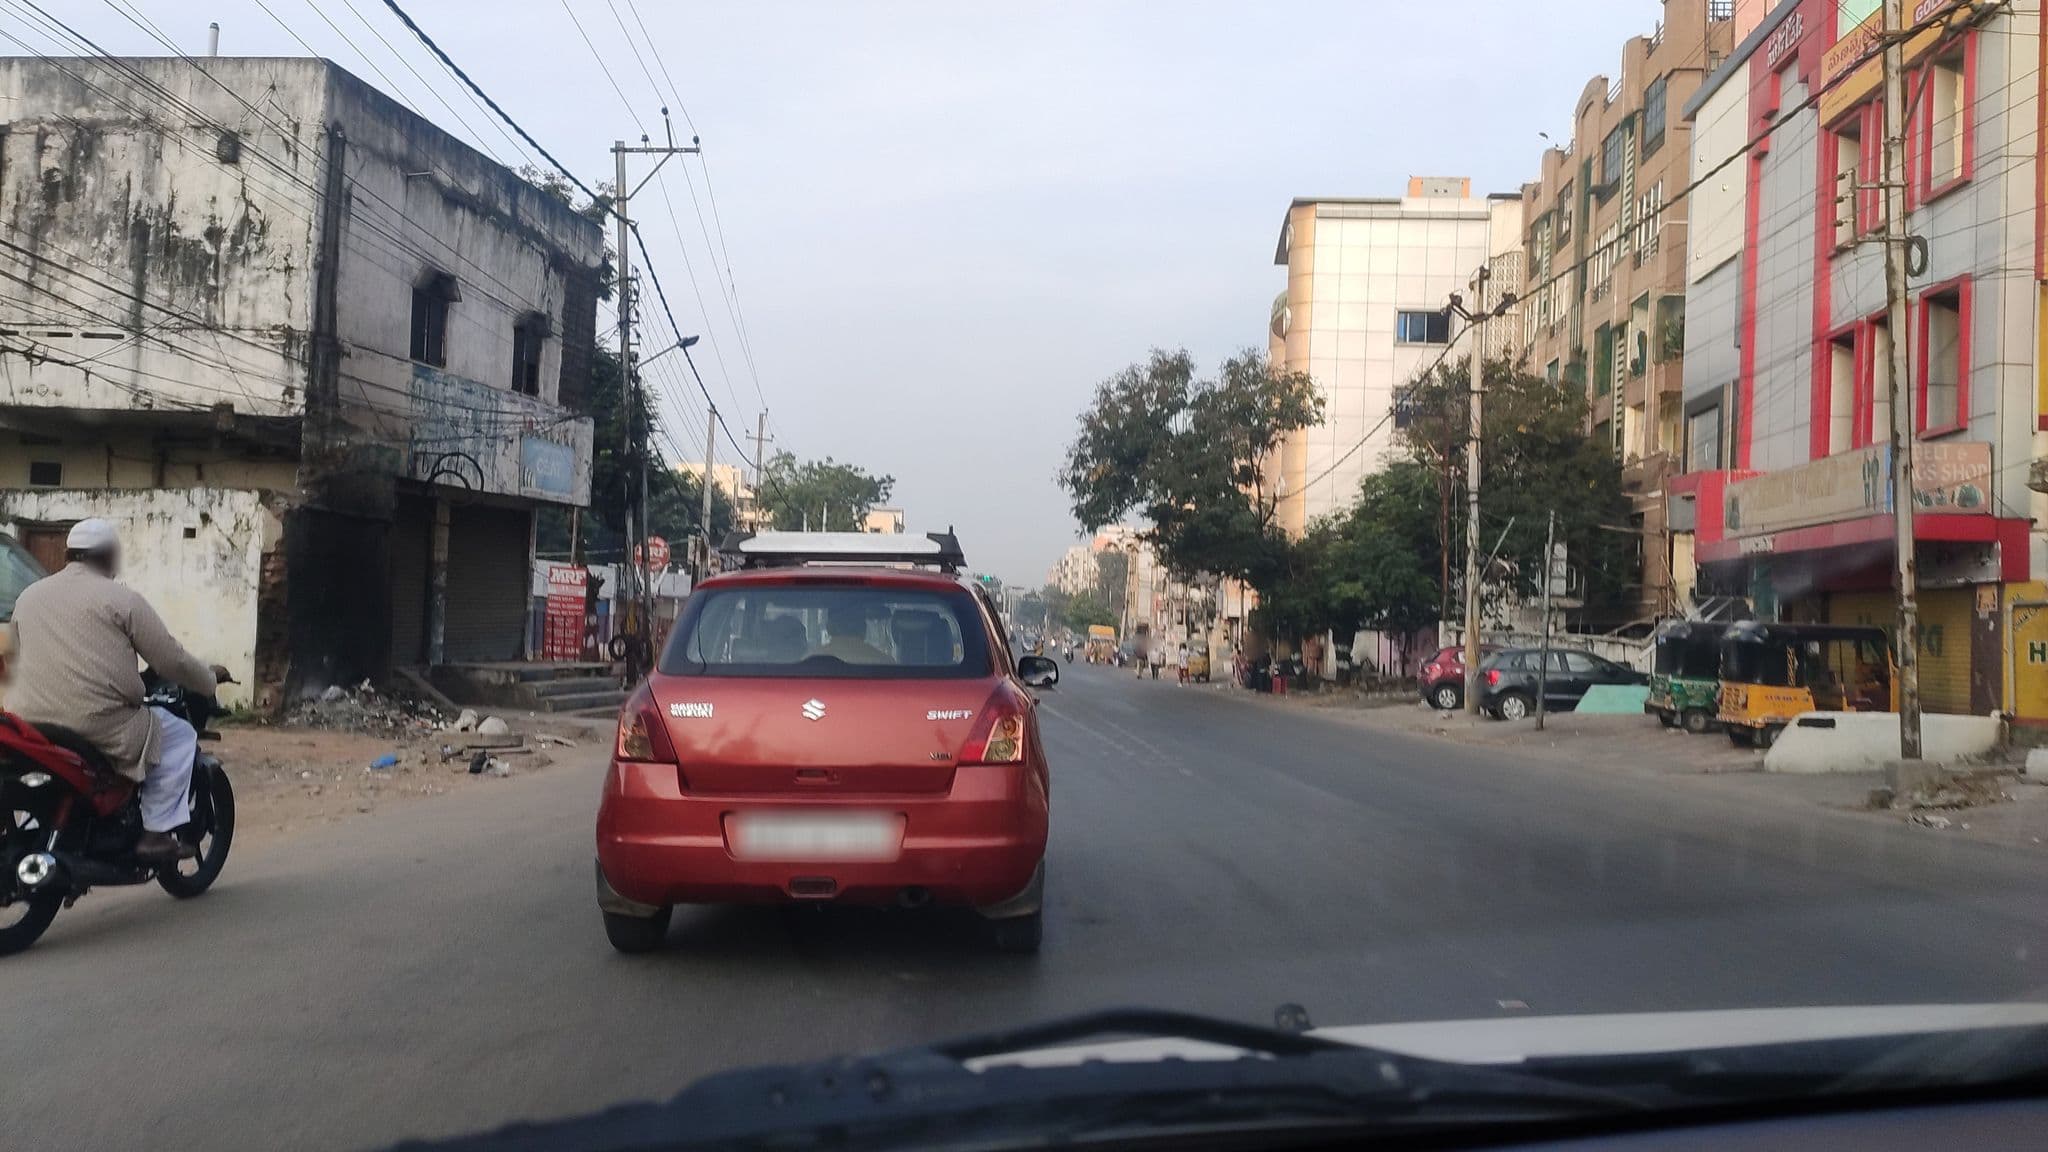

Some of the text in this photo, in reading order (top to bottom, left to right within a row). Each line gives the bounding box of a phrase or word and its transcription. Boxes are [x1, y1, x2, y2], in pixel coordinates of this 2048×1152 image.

[1941, 463, 1987, 482] SHOP
[550, 567, 587, 585] MRF
[670, 702, 713, 711] MARUTI
[926, 709, 973, 721] SWIFT
